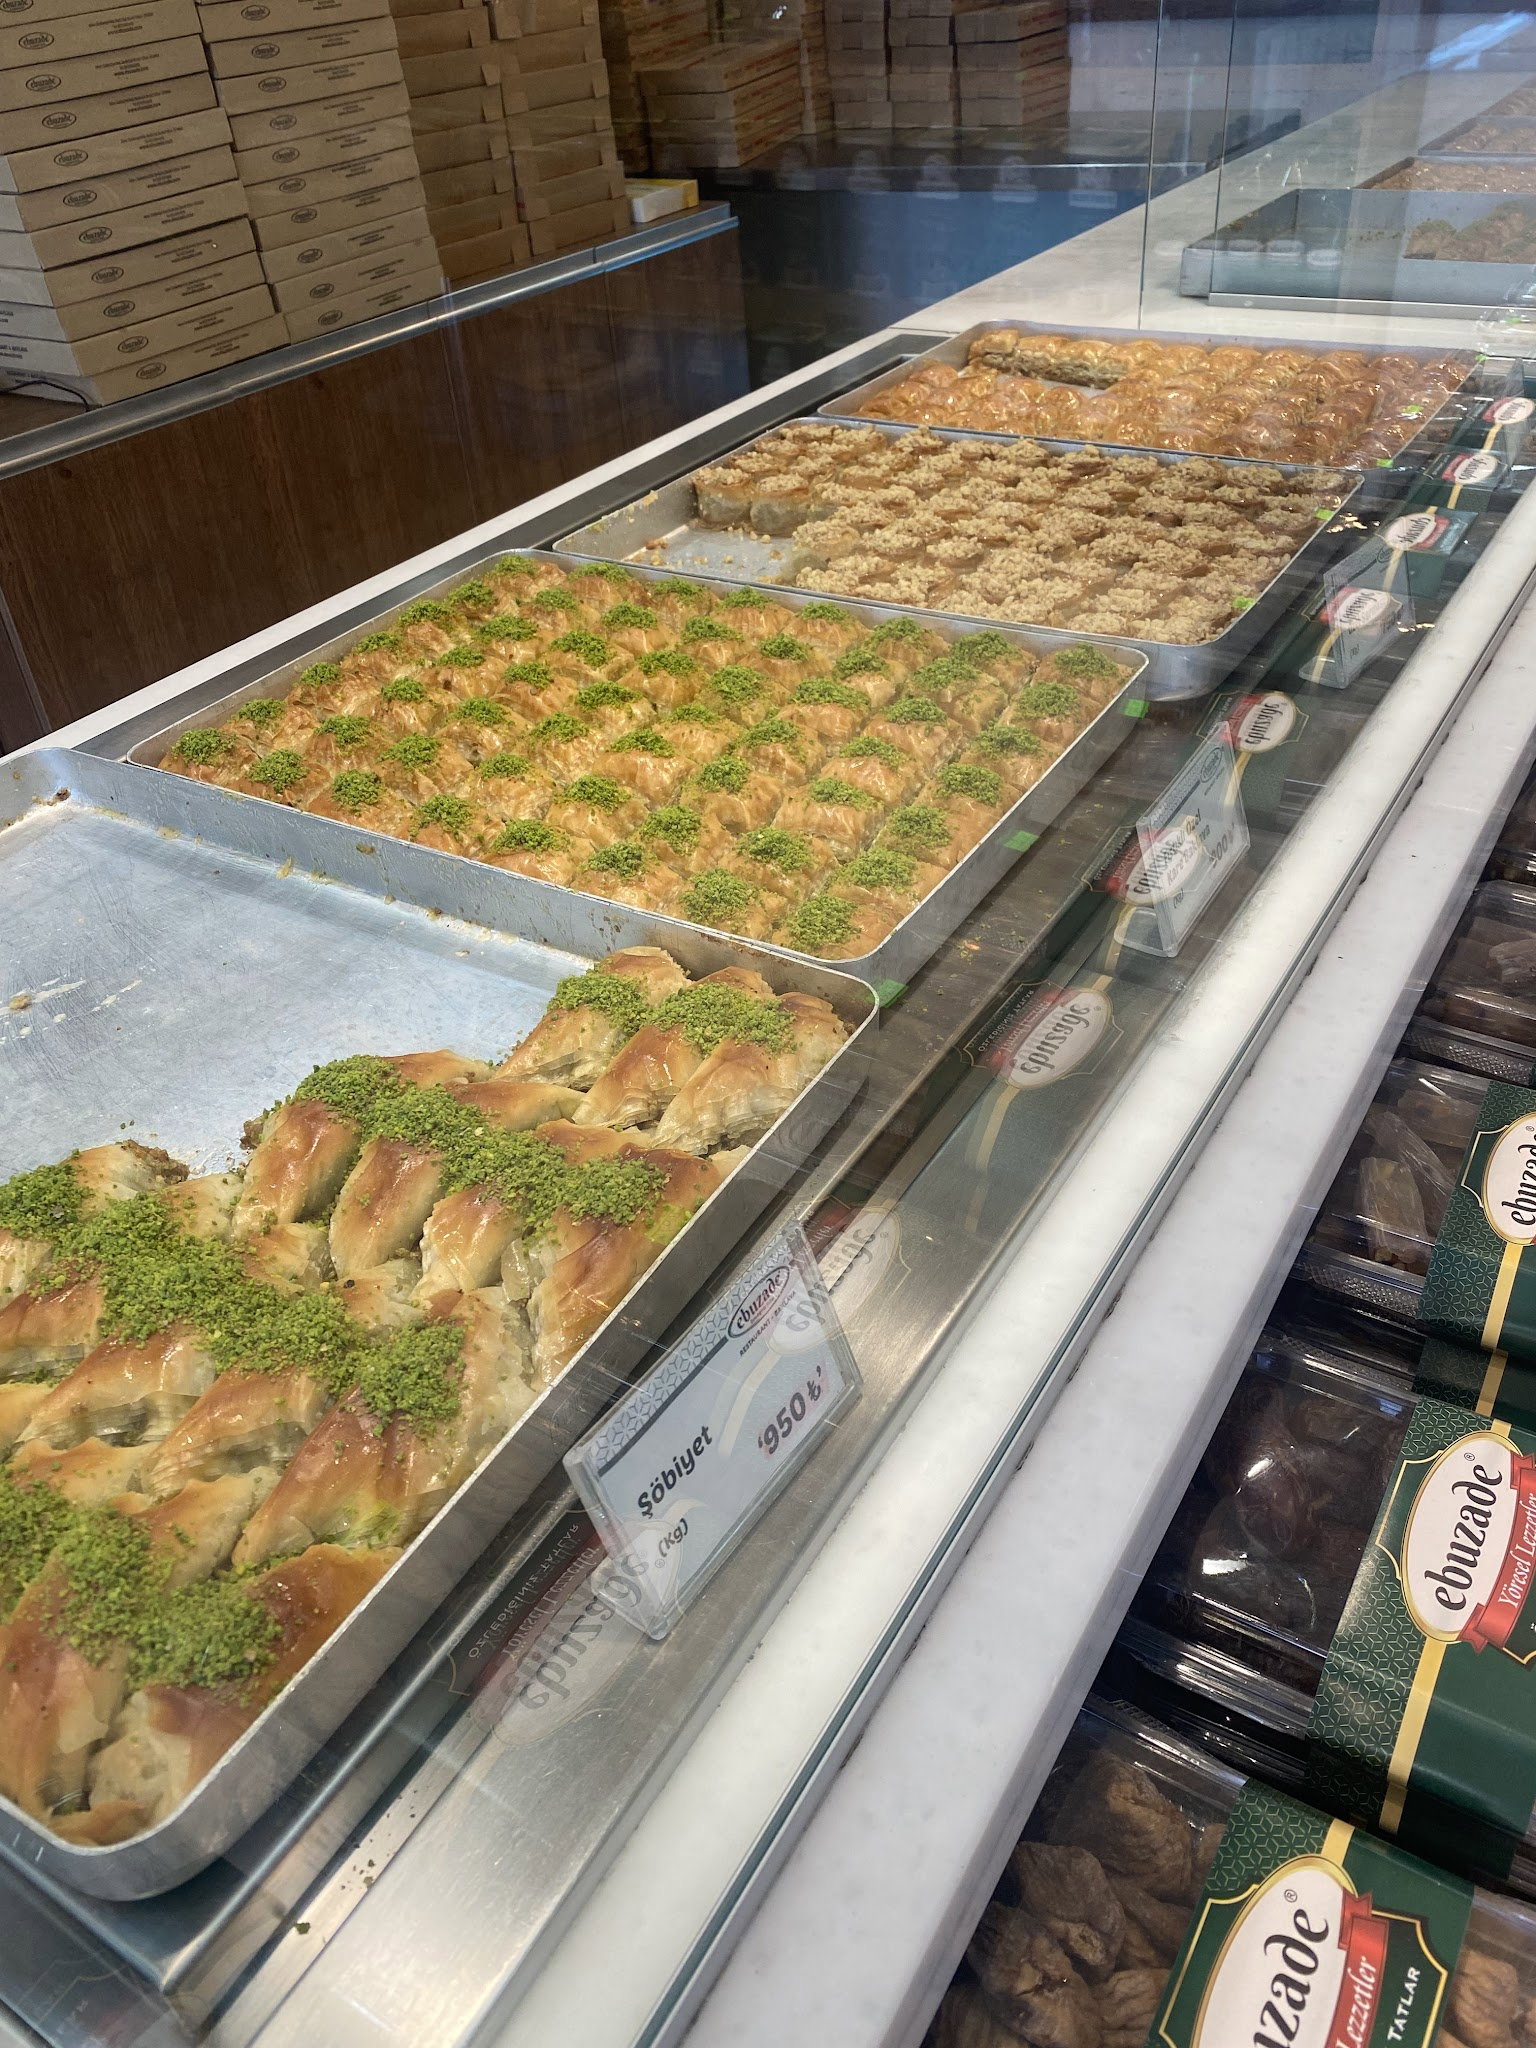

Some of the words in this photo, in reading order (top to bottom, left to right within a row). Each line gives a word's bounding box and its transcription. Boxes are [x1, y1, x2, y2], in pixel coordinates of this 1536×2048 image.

[736, 1273, 781, 1329] ebuzade
[739, 1319, 772, 1356] RESTAURANT
[638, 1425, 713, 1519] Şöbiyet
[658, 1518, 689, 1558] (Kg)
[1424, 1464, 1503, 1611] ebuzade
[1498, 1550, 1530, 1609] Yöresel
[1387, 1966, 1421, 2041] TATLAR
